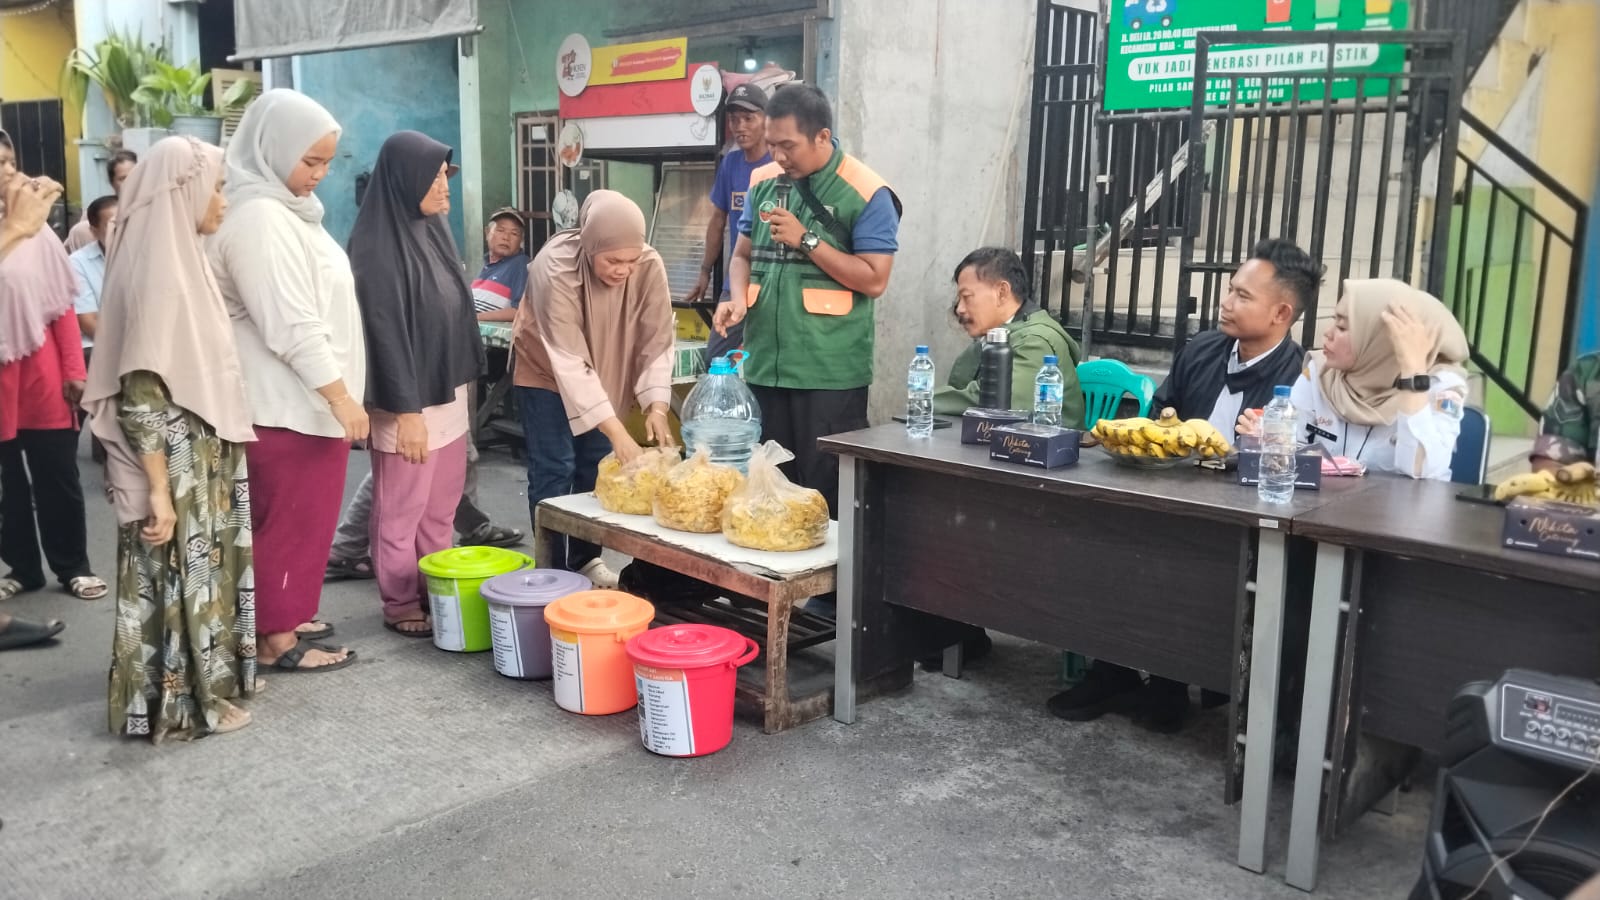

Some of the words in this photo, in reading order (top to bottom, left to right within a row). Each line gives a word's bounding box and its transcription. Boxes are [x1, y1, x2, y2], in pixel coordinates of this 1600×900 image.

[1138, 63, 1159, 75] YUK
[1165, 60, 1191, 73] JADI
[1203, 55, 1259, 71] ENERASI
[1266, 51, 1303, 67] PILAH
[1310, 47, 1368, 64] PLSTIK
[1149, 83, 1174, 93] PILAH
[1177, 79, 1212, 92] SAMH
[1220, 90, 1243, 101] BAK
[1247, 88, 1284, 99] SAPAH
